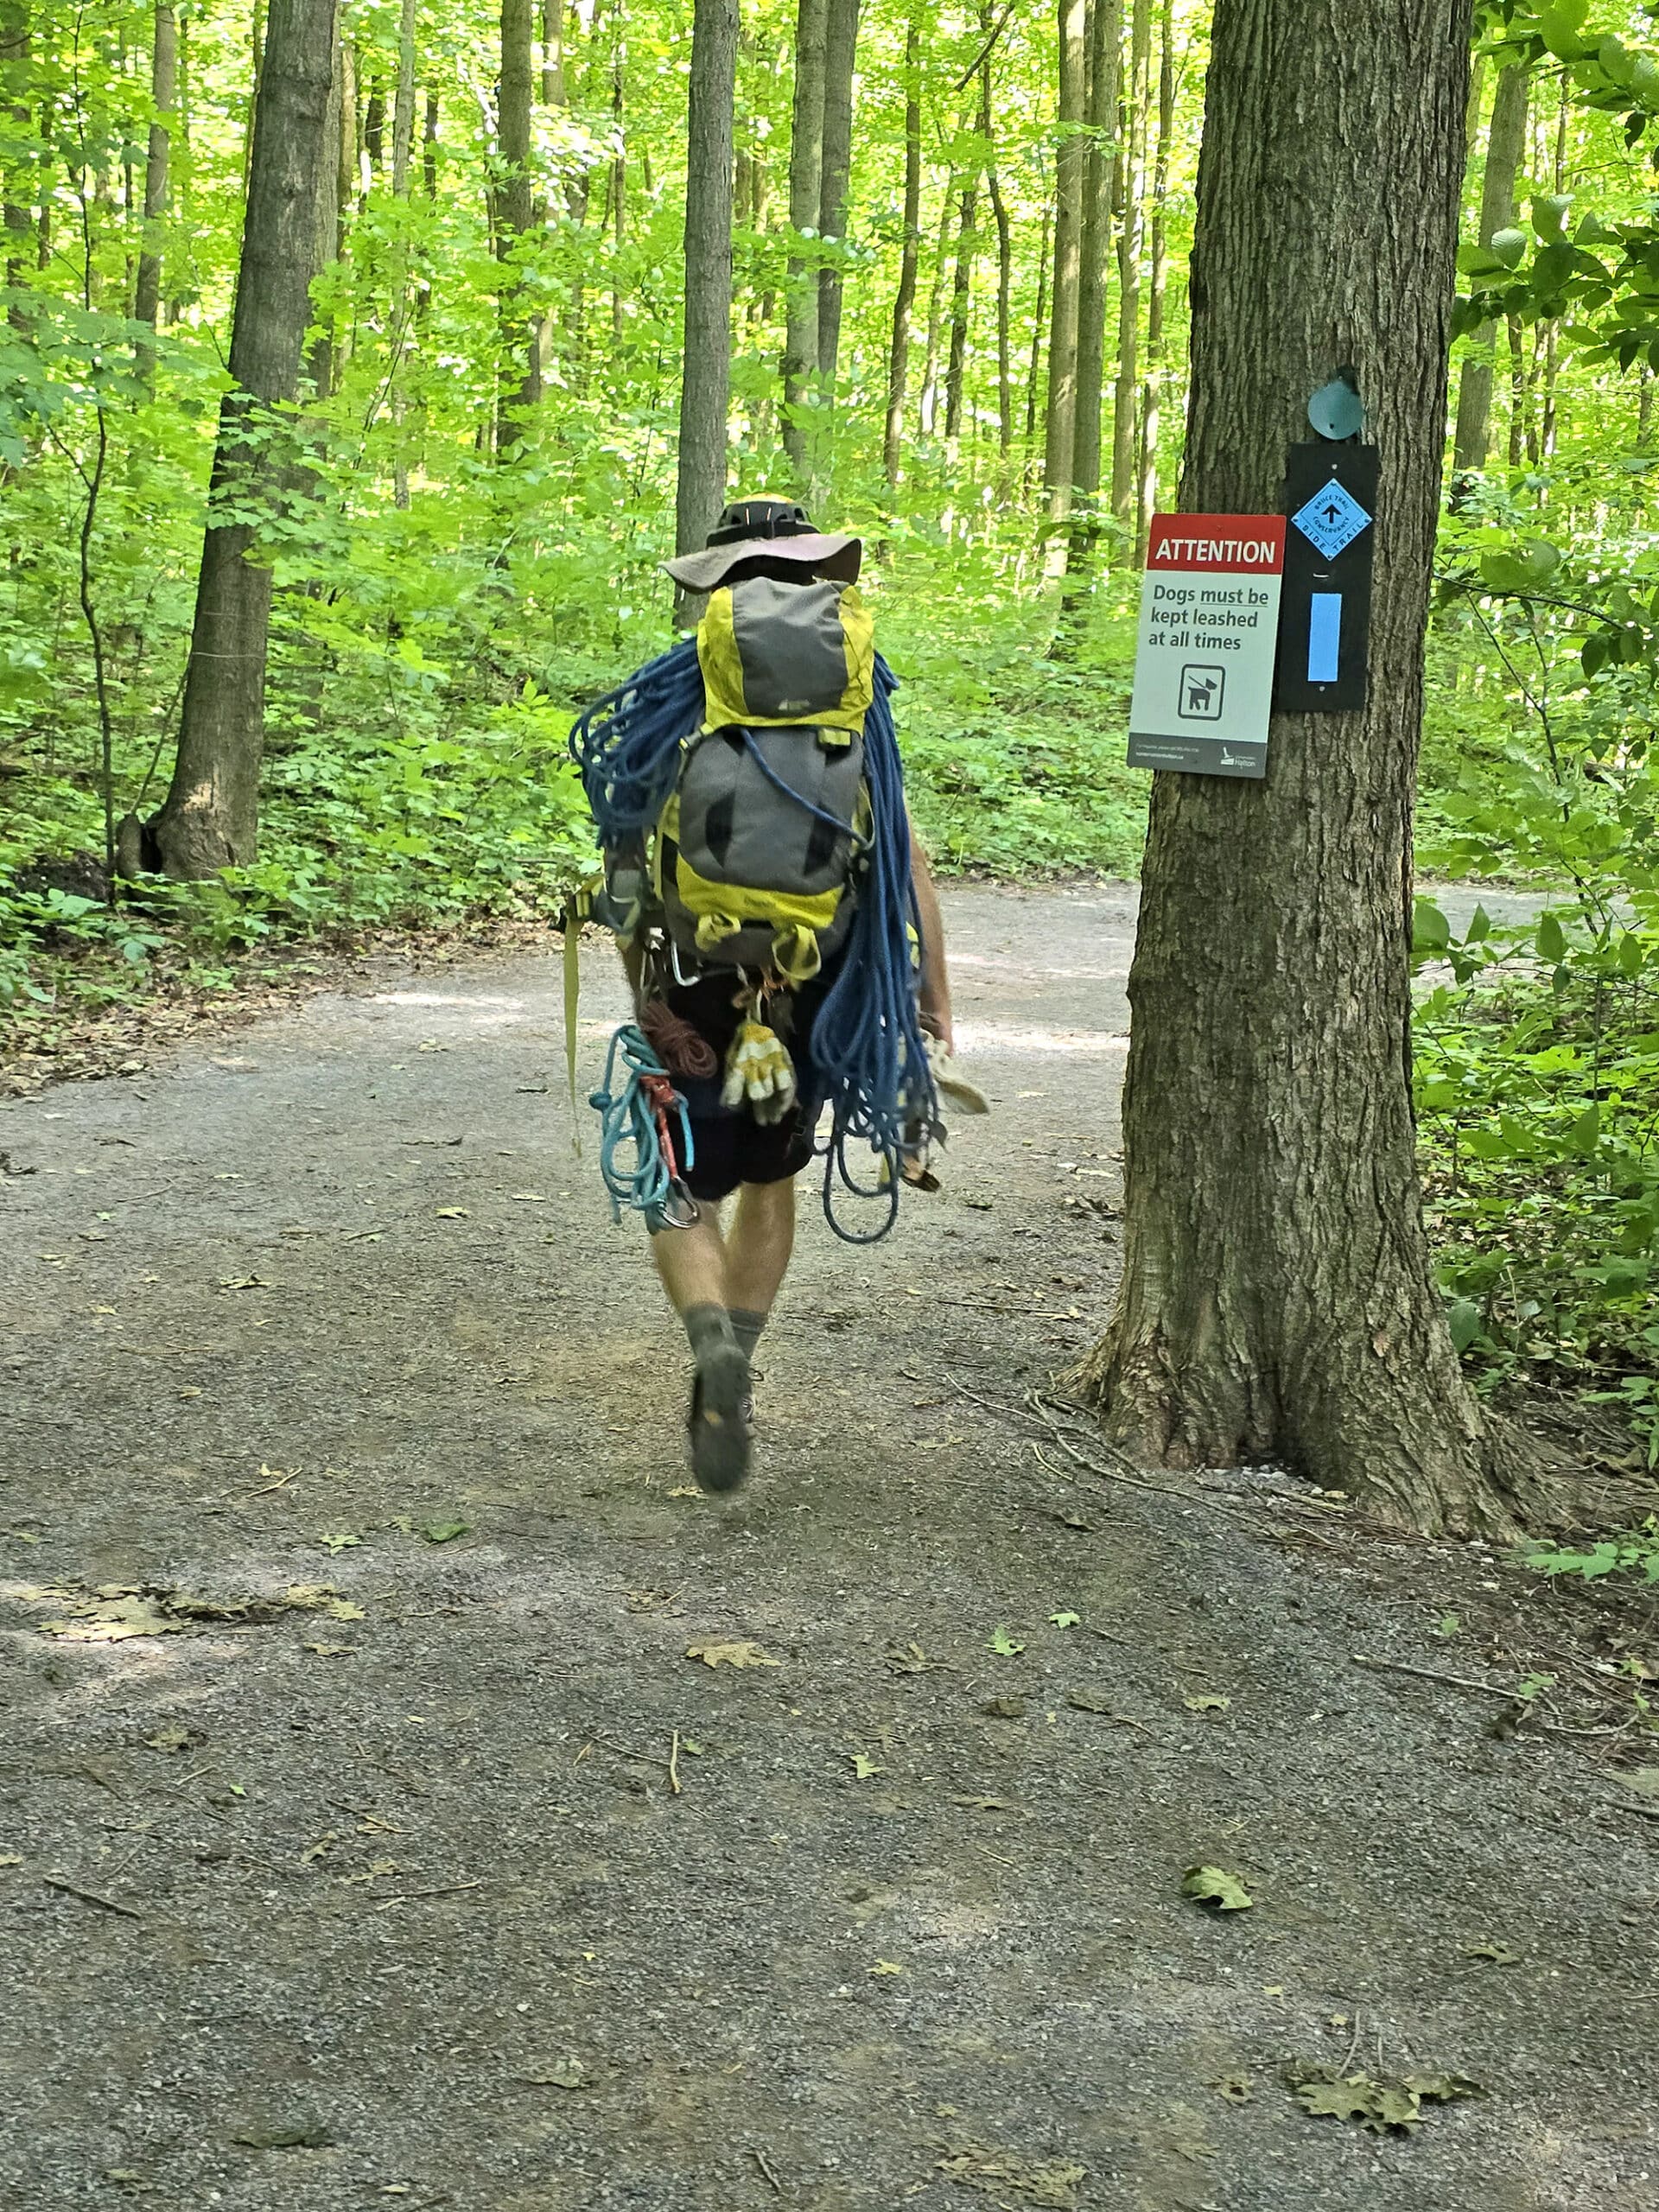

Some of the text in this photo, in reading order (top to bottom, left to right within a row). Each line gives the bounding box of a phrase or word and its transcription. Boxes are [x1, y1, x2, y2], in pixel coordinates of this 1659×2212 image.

[1314, 494, 1350, 510] BRUCE TRAIL
[1313, 516, 1350, 534] CONSERVANCY
[1302, 523, 1363, 551] SIDE TRAIL
[1155, 538, 1275, 563] ATTENTION
[1154, 584, 1268, 605] Dogs must be
[1151, 607, 1258, 627] kept leashed
[1148, 631, 1242, 650] at all times
